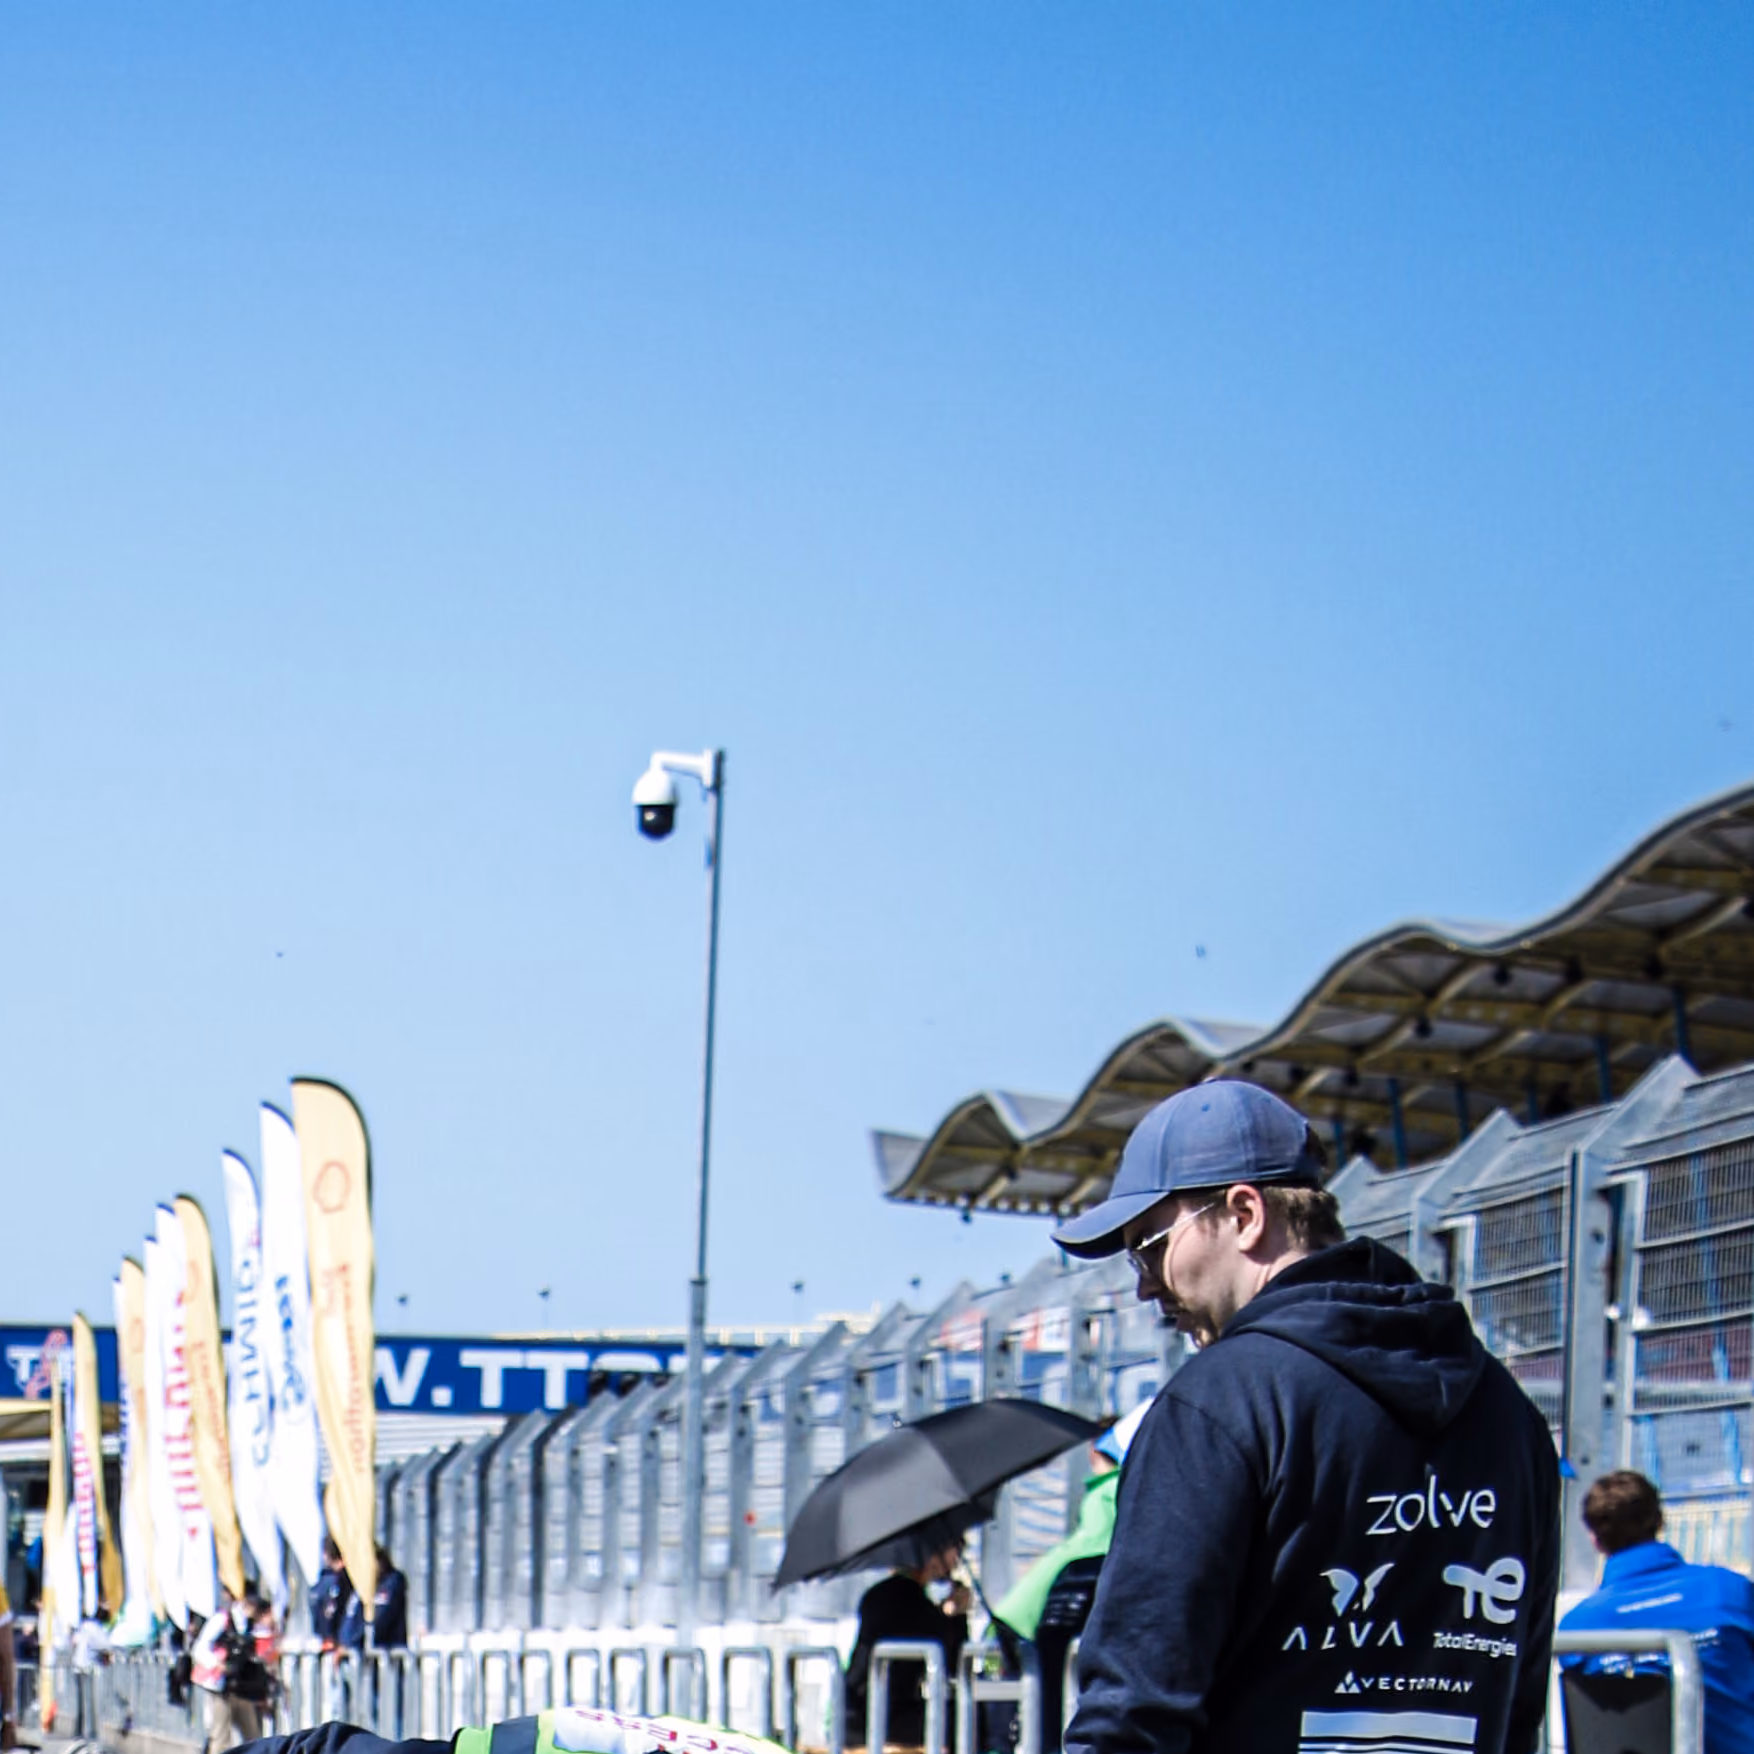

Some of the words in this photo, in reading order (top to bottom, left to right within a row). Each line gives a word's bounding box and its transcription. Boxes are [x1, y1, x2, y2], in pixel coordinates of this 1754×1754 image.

[1365, 1474, 1496, 1535] zolve
[1281, 1619, 1404, 1651] ALVA
[1433, 1631, 1517, 1657] TotalEnergies
[1361, 1676, 1474, 1694] VECTORNAV
